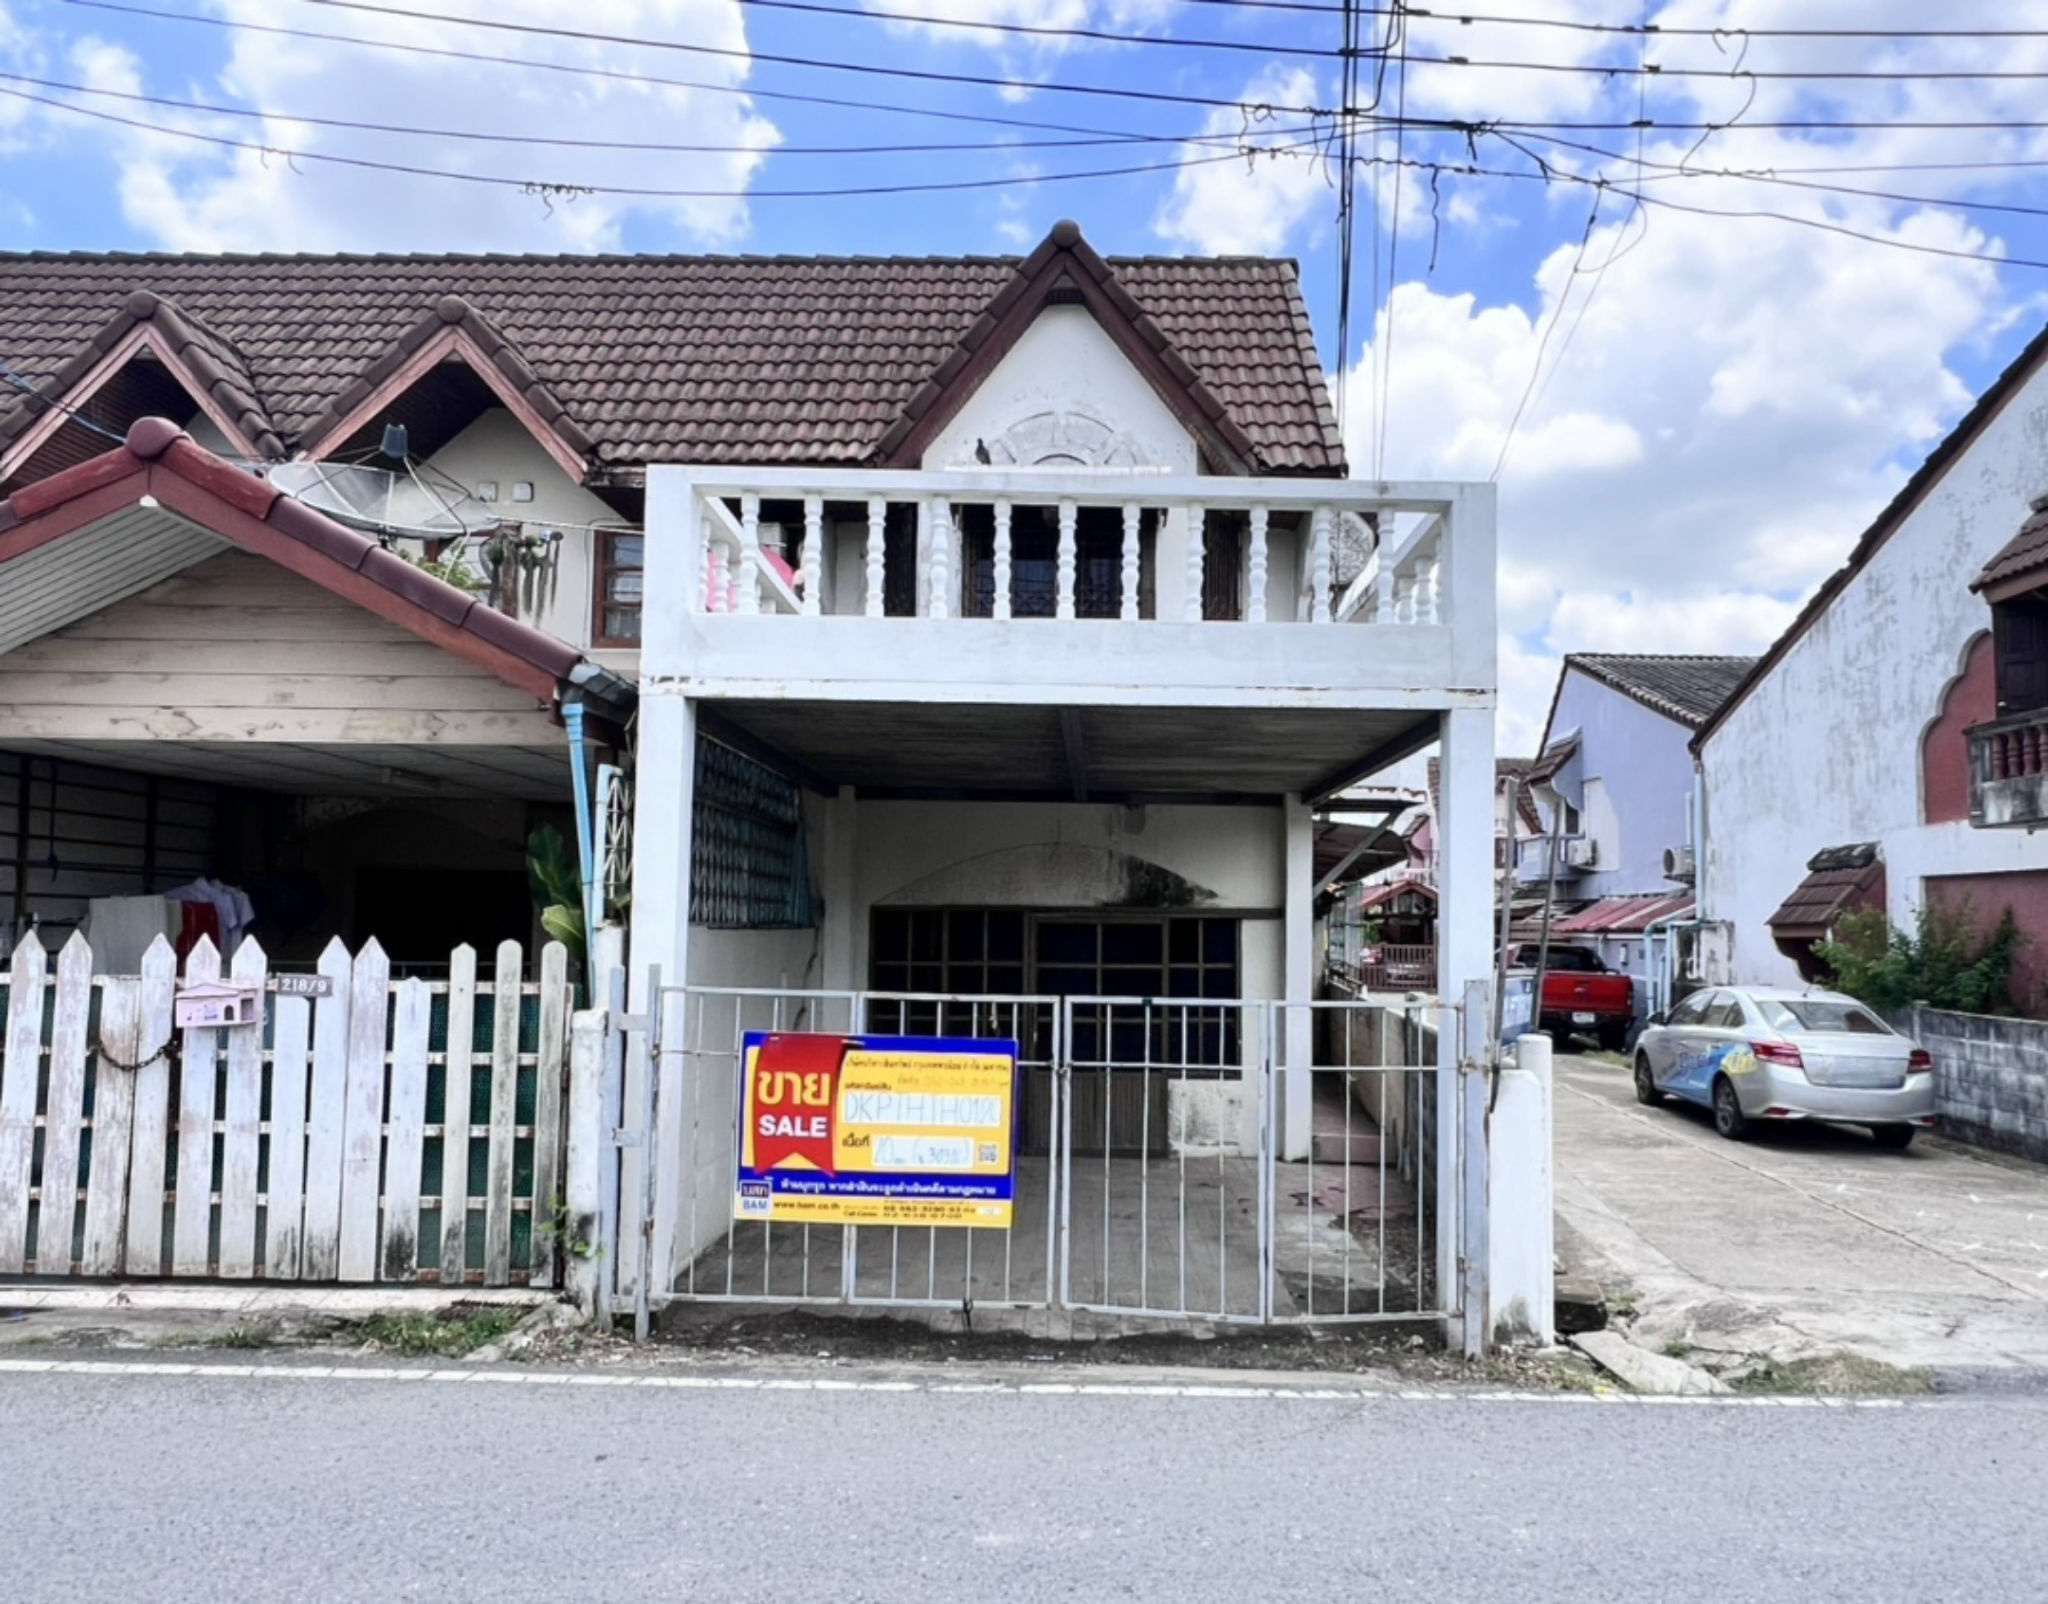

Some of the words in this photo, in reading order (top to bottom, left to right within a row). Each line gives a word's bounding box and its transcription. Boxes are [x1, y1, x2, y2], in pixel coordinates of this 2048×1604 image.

[282, 977, 327, 993] 218/9
[758, 1070, 831, 1106] ขาย
[759, 1114, 828, 1139] SALE
